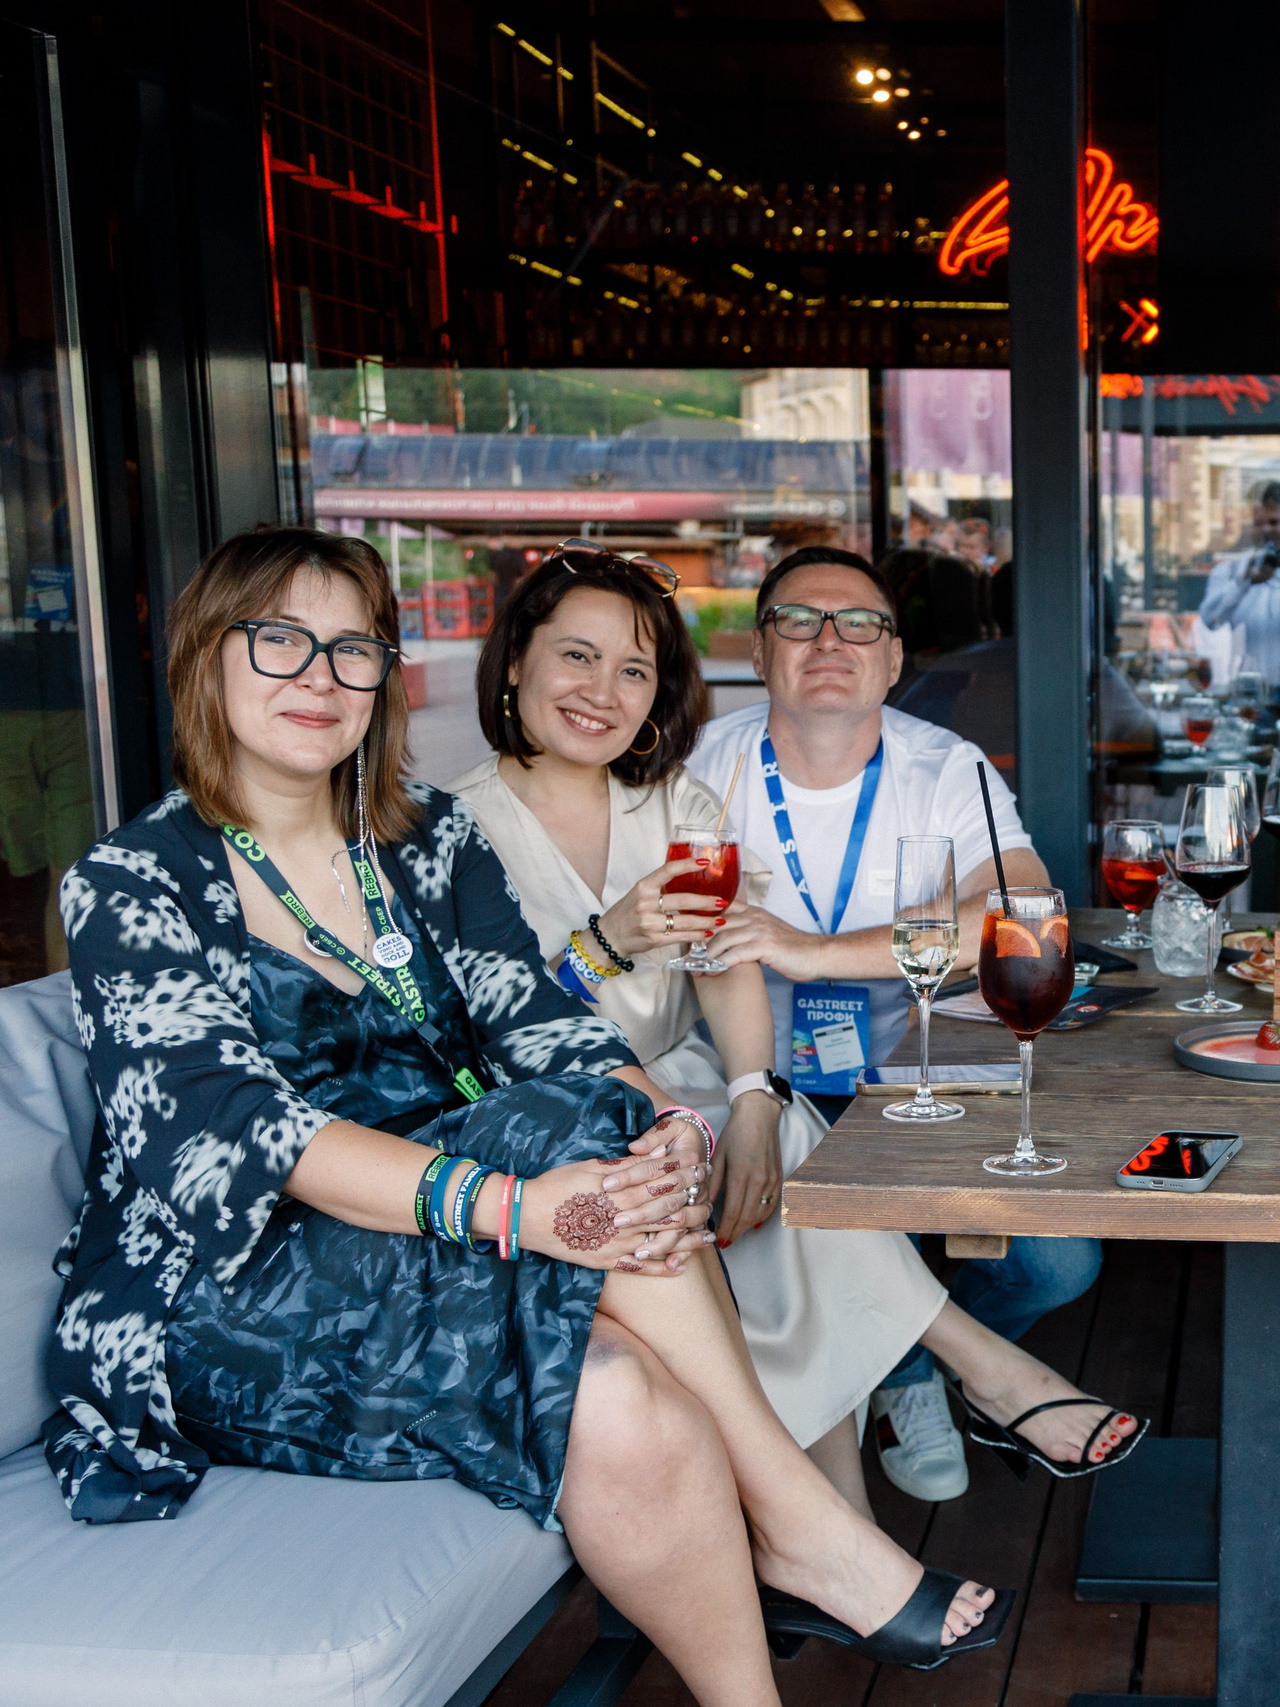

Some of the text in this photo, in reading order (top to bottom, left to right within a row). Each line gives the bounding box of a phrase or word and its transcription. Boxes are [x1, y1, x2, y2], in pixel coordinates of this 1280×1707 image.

[285, 895, 313, 926] REBRO
[376, 935, 402, 950] CAKES
[348, 957, 412, 1021] STREET
[394, 964, 426, 1023] GASTR
[797, 998, 864, 1011] GASTREET
[807, 1011, 854, 1022] ПРОФИ
[465, 1076, 484, 1096] GAS
[428, 1157, 447, 1180] REBRO
[417, 1193, 426, 1230] GASTREET
[455, 1166, 482, 1236] GASTREET FAMILY
